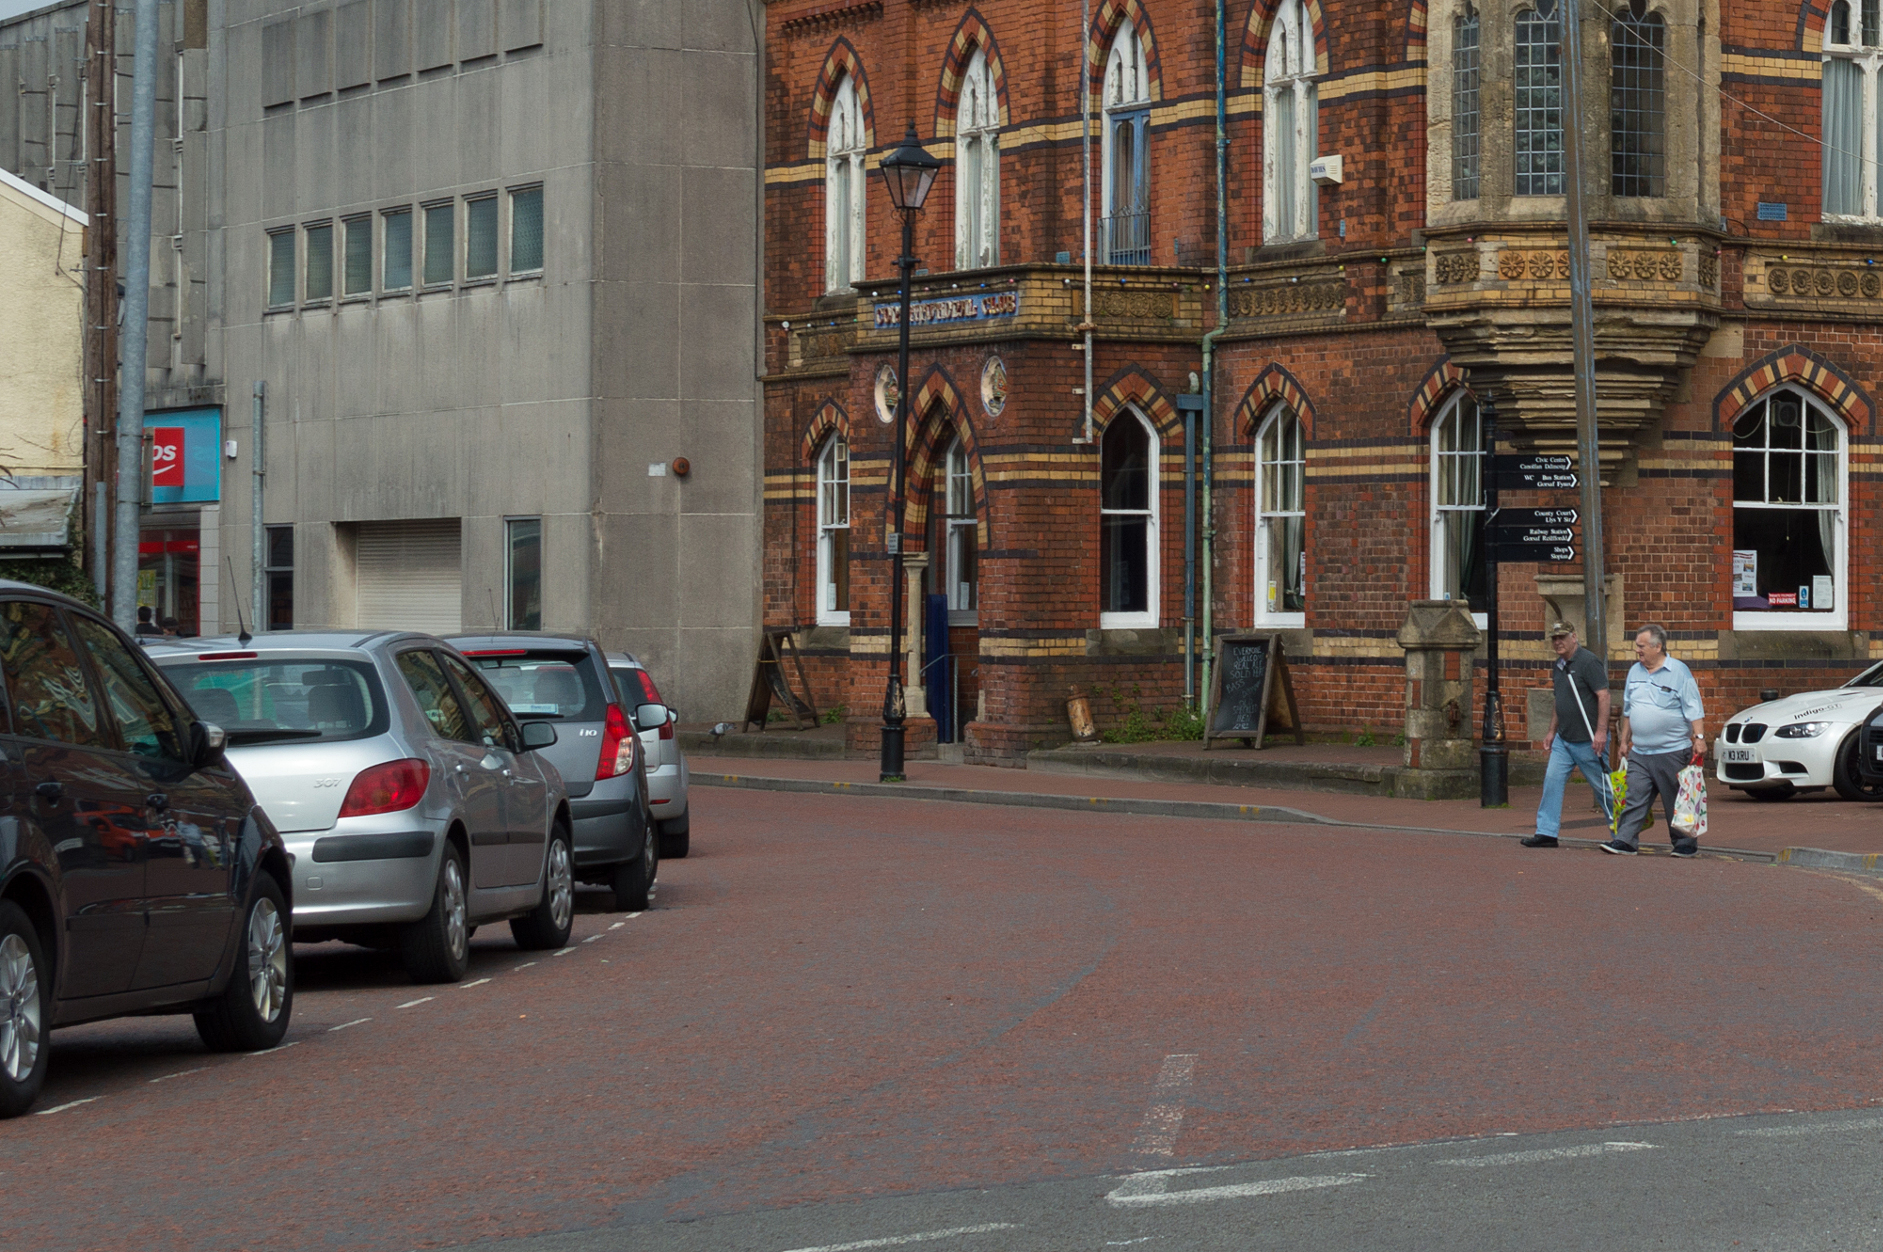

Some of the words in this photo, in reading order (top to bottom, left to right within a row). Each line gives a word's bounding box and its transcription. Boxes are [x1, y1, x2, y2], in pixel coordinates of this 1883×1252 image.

[981, 293, 1017, 315] CLUB
[1230, 669, 1251, 679] SOLD
[1226, 679, 1245, 694] BASS
[1737, 750, 1749, 760] XRU
[314, 778, 341, 788] 307
